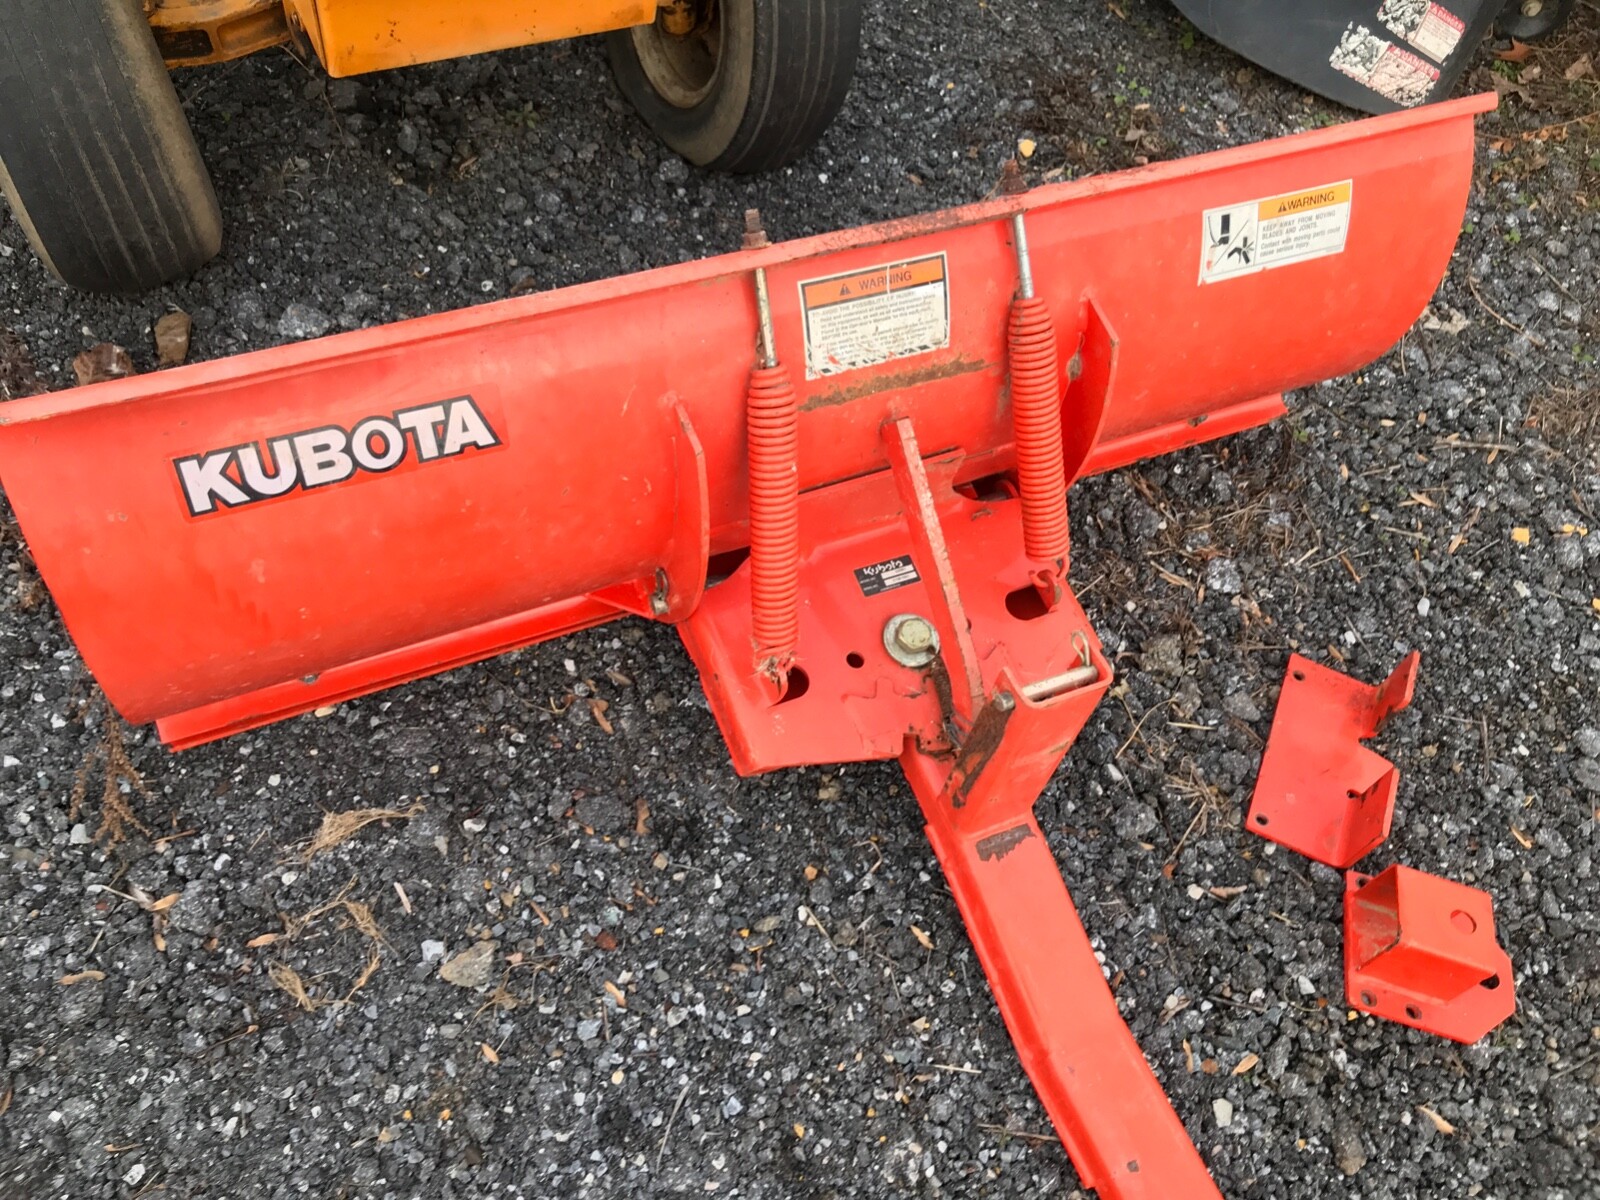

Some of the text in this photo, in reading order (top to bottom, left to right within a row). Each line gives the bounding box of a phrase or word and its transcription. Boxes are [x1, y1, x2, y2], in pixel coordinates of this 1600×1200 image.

[1287, 191, 1334, 211] WARNING
[1262, 210, 1335, 232] KEEP AWAY FROM MOVING
[1261, 225, 1340, 250] Contact with moving parts could
[1262, 230, 1282, 240] BLADES
[1285, 227, 1295, 235] AND
[1260, 249, 1273, 257] cause
[1276, 245, 1293, 253] serious
[858, 270, 911, 291] WARNING
[173, 395, 502, 516] KUBOTA
